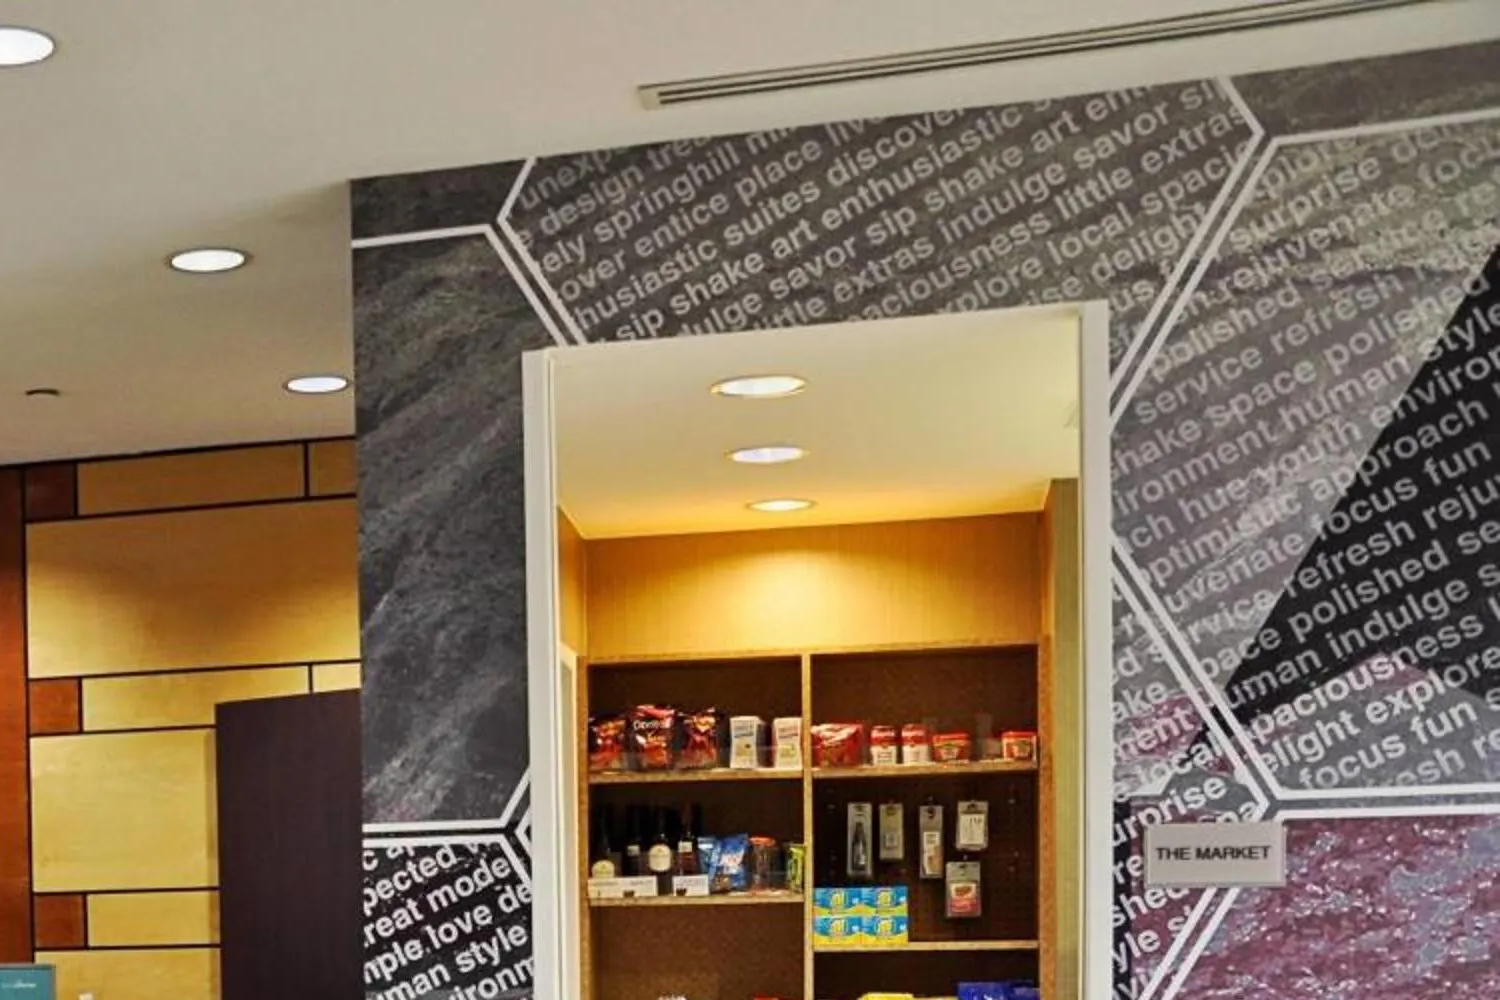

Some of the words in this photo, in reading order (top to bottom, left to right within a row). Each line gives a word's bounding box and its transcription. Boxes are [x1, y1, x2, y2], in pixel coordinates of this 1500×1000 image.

[540, 164, 645, 235] design
[594, 141, 740, 243] springhill
[635, 192, 729, 257] entice
[735, 139, 822, 208] place
[670, 252, 765, 315] shake
[771, 218, 819, 260] art
[821, 107, 1023, 230] enthusiastic
[723, 180, 821, 247] suites
[769, 236, 856, 299] savor
[866, 206, 917, 245] sip
[924, 145, 1024, 212] shake
[1030, 110, 1081, 154] art
[833, 236, 935, 302] extras
[936, 162, 1067, 244] indulge
[1073, 101, 1169, 170] savor
[1047, 201, 1134, 266] local
[1054, 167, 1134, 221] little
[1230, 157, 1381, 252] surprise
[1135, 348, 1263, 424] service
[1270, 273, 1403, 355] refresh
[1151, 279, 1300, 383] polished
[1204, 359, 1317, 427] space
[1325, 272, 1490, 376] polished
[1277, 353, 1412, 433] human
[1310, 400, 1489, 502] approach
[1311, 477, 1419, 541] focus
[1423, 441, 1492, 486] fun
[1178, 477, 1250, 524] hue
[1284, 520, 1416, 598] refresh
[1288, 539, 1450, 643] polished
[1325, 579, 1470, 660] indulge
[1299, 734, 1407, 789] focus
[1410, 701, 1477, 745] fun
[1156, 847, 1192, 861] THE
[1195, 845, 1272, 861] MARKET
[425, 903, 493, 950] love
[455, 924, 529, 974] style
